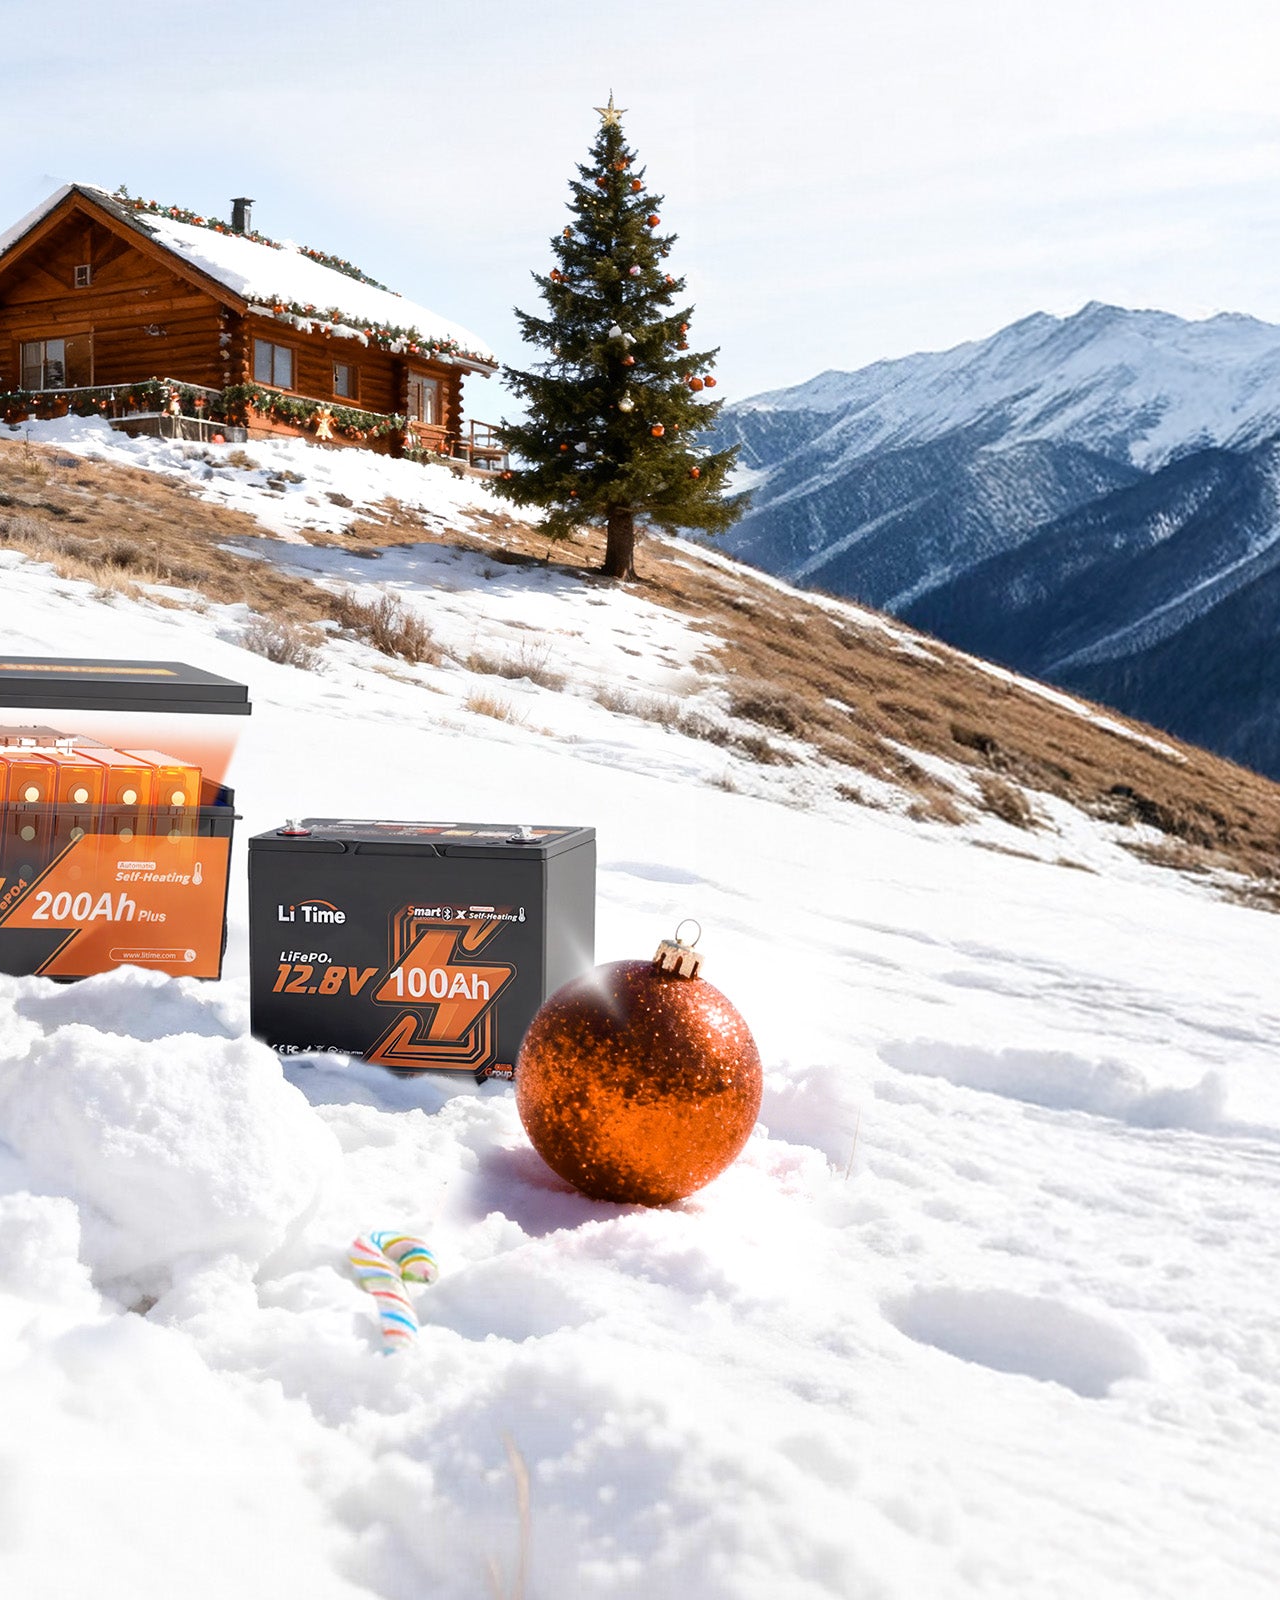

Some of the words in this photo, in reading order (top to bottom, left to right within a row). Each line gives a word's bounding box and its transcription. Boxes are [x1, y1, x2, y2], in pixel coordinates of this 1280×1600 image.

[115, 871, 192, 886] Self-Heating
[32, 891, 137, 922] 200Ah
[137, 910, 167, 923] Plus
[278, 904, 295, 923] Li
[300, 904, 347, 925] Time
[407, 905, 441, 917] Smart
[469, 912, 518, 922] Self-Heating
[123, 951, 177, 960] www.litime.com
[272, 965, 380, 996] 12.8V
[389, 966, 490, 1000] 100Ah
